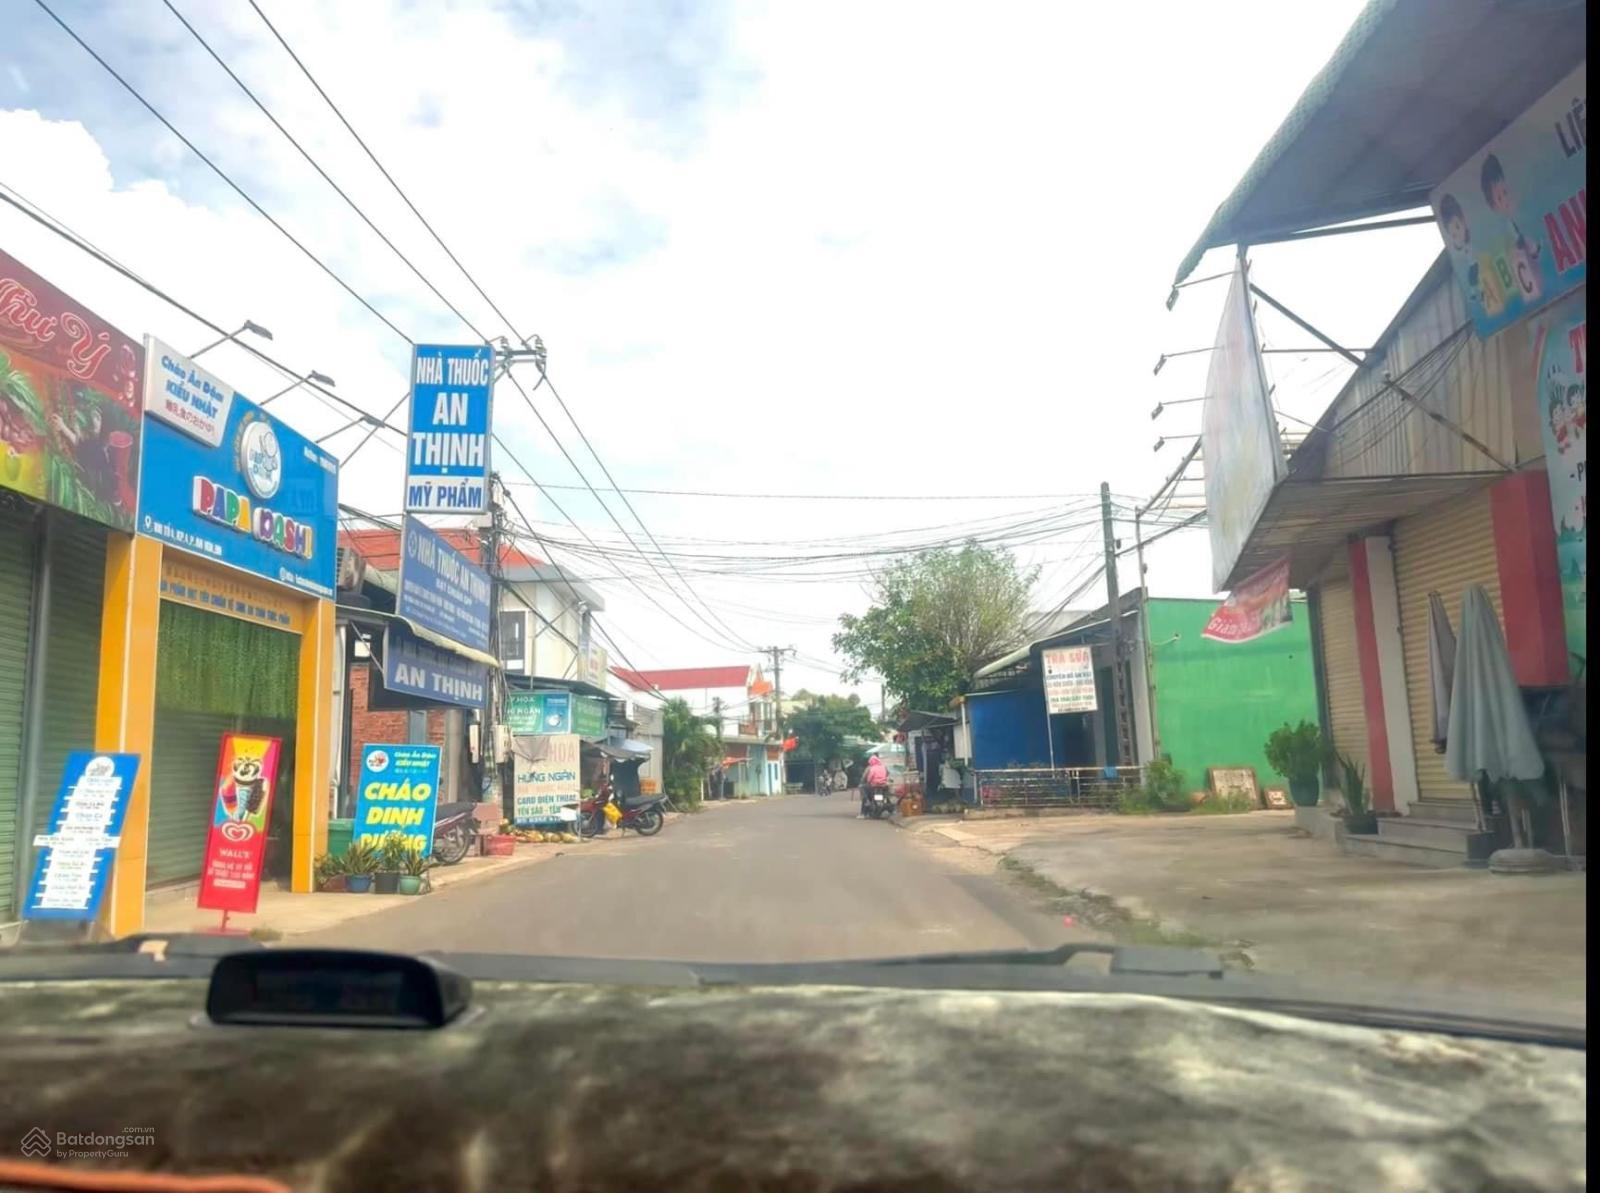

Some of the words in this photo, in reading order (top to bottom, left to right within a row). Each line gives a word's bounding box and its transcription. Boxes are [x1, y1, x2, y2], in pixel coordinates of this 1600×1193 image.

[61, 312, 111, 379] Ý
[416, 354, 444, 386] NHÀ
[448, 349, 489, 387] THUỐC
[432, 393, 468, 427] AN
[413, 433, 485, 474] THỊNH
[193, 475, 252, 534] PAPA
[408, 479, 434, 509] MỸ
[437, 477, 482, 509] PHẨM
[394, 662, 426, 688] AN
[432, 672, 483, 702] THỊNH
[364, 777, 432, 801] CHÁO
[365, 806, 425, 826] DINH
